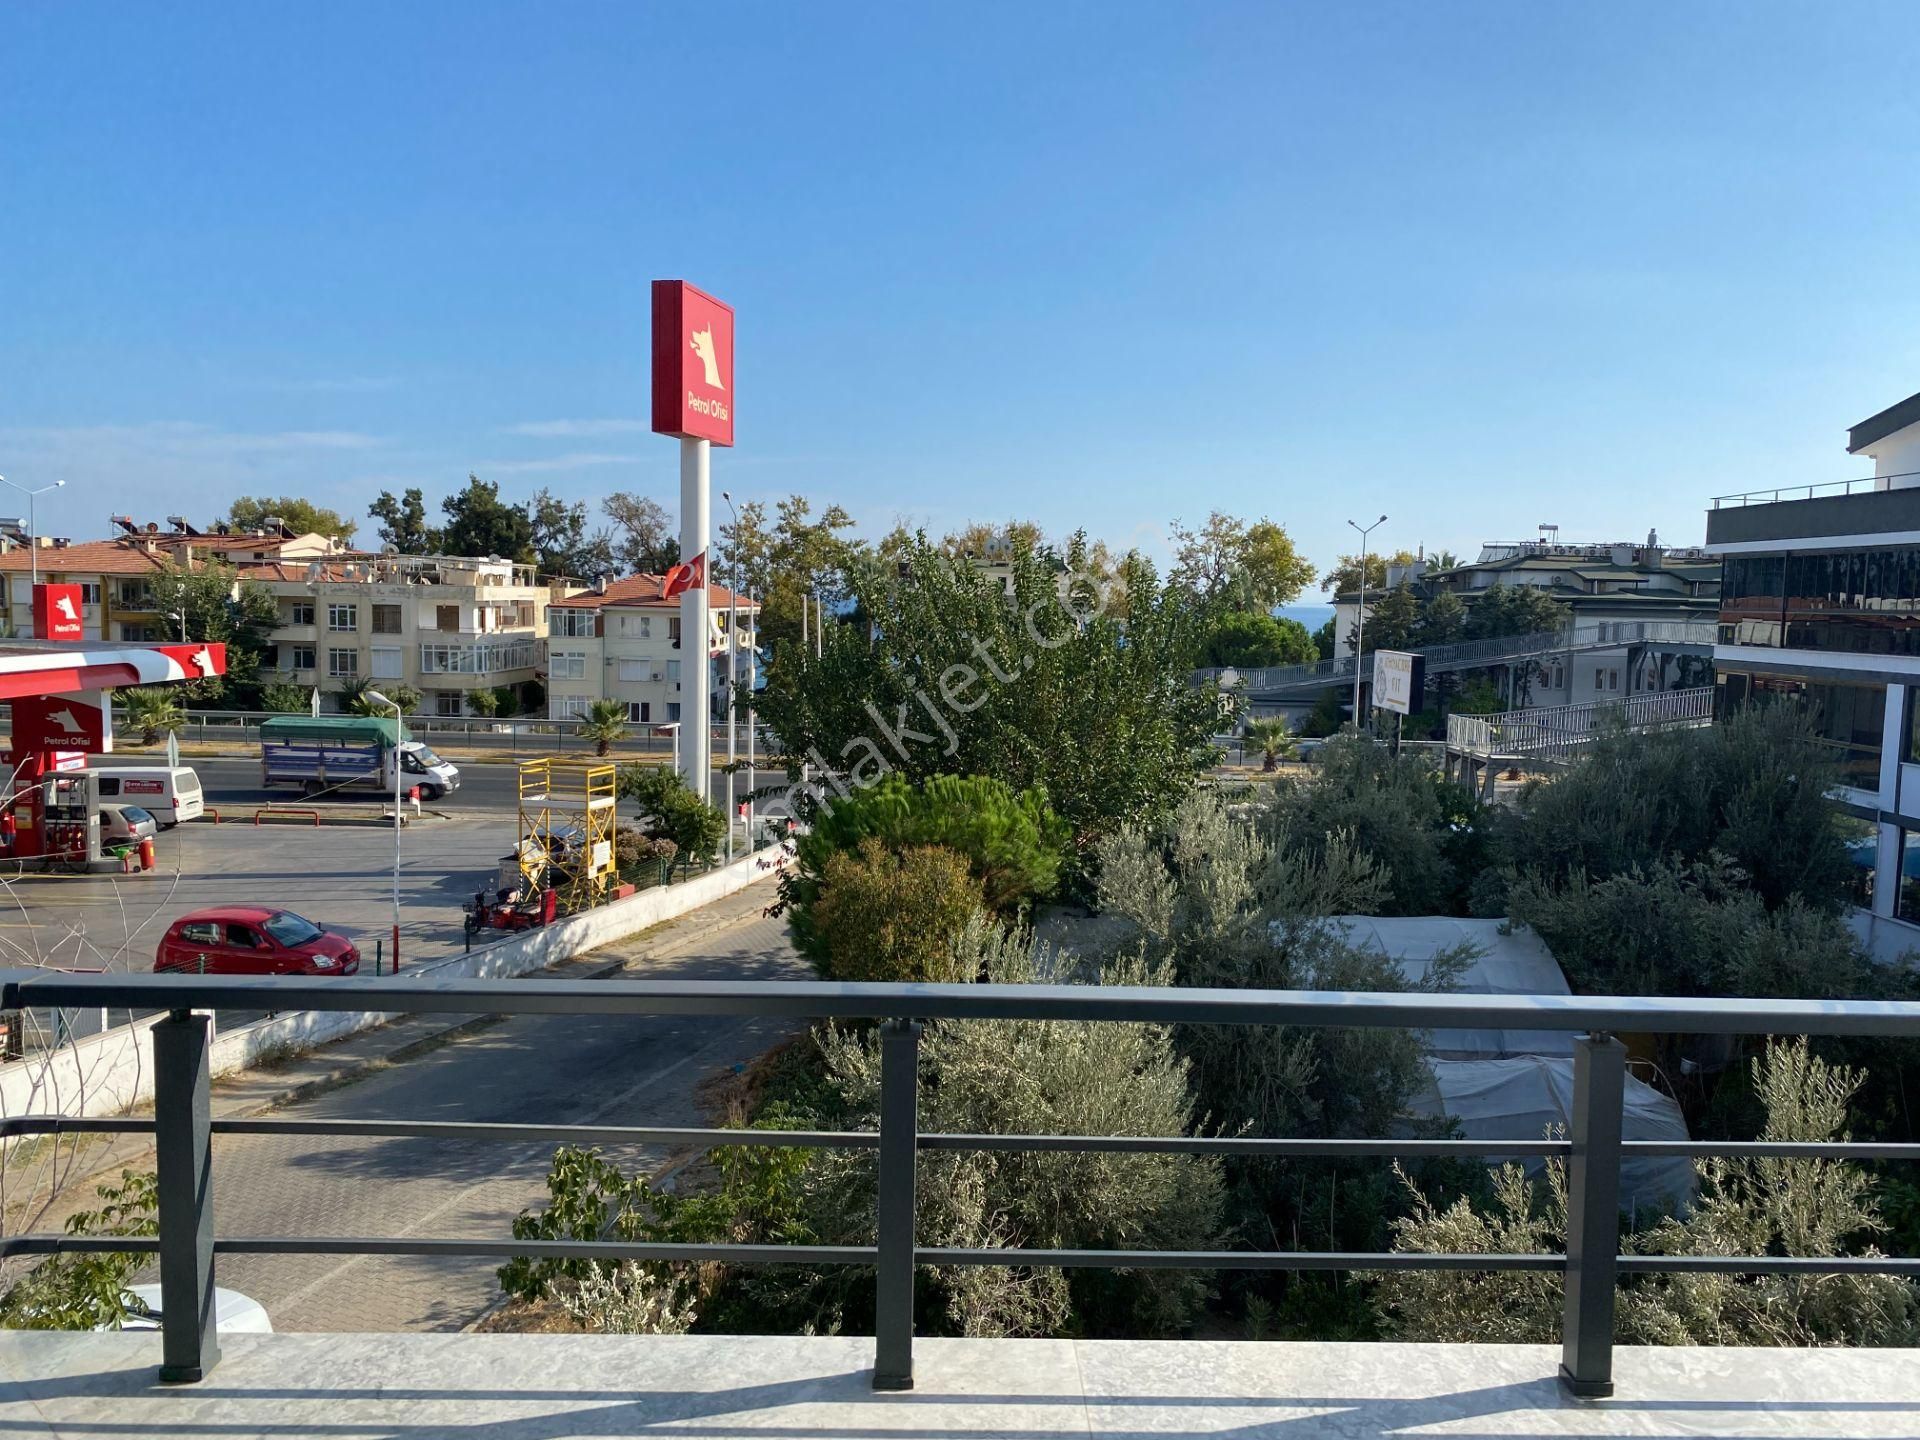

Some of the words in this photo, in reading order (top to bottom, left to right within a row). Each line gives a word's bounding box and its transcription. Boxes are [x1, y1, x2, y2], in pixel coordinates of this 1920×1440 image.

[688, 391, 710, 415] Petrol
[711, 399, 728, 422] Ofisi
[55, 624, 69, 633] Petrol
[44, 736, 69, 745] Petrol
[70, 737, 90, 746] Ofisi
